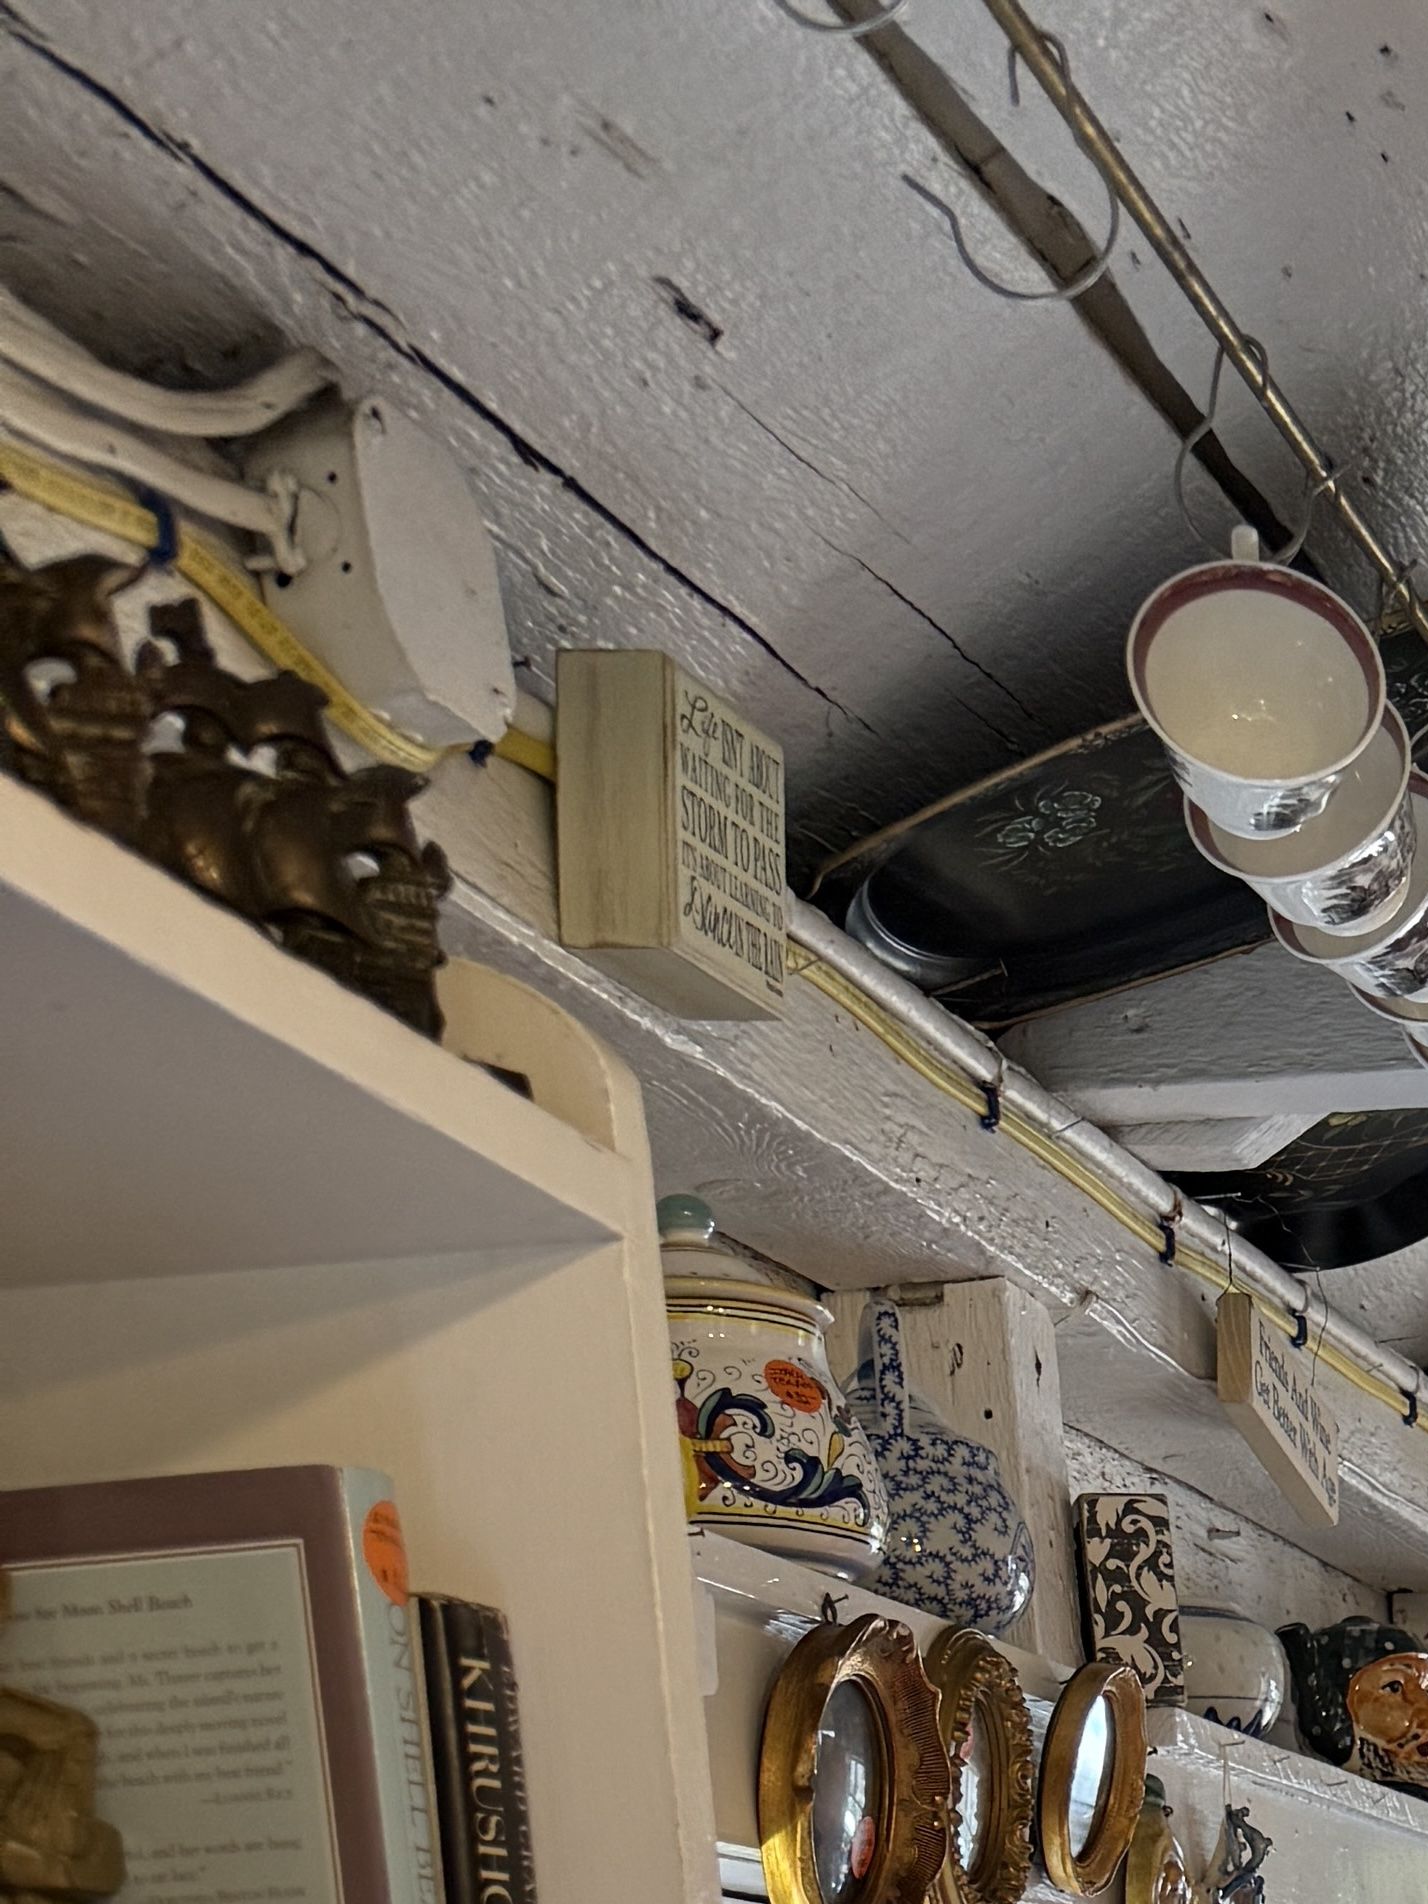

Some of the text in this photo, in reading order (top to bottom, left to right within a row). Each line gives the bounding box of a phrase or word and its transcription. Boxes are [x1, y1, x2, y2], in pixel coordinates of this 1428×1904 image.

[680, 689, 719, 756] Life
[679, 743, 780, 845] WAITING FOR THE
[681, 786, 782, 896] STORM TO PASS
[1255, 1360, 1270, 1410] Get
[1272, 1383, 1297, 1448] Better
[1259, 1318, 1289, 1392] Friends
[1291, 1372, 1308, 1422] And
[393, 1686, 428, 1829] SHELL
